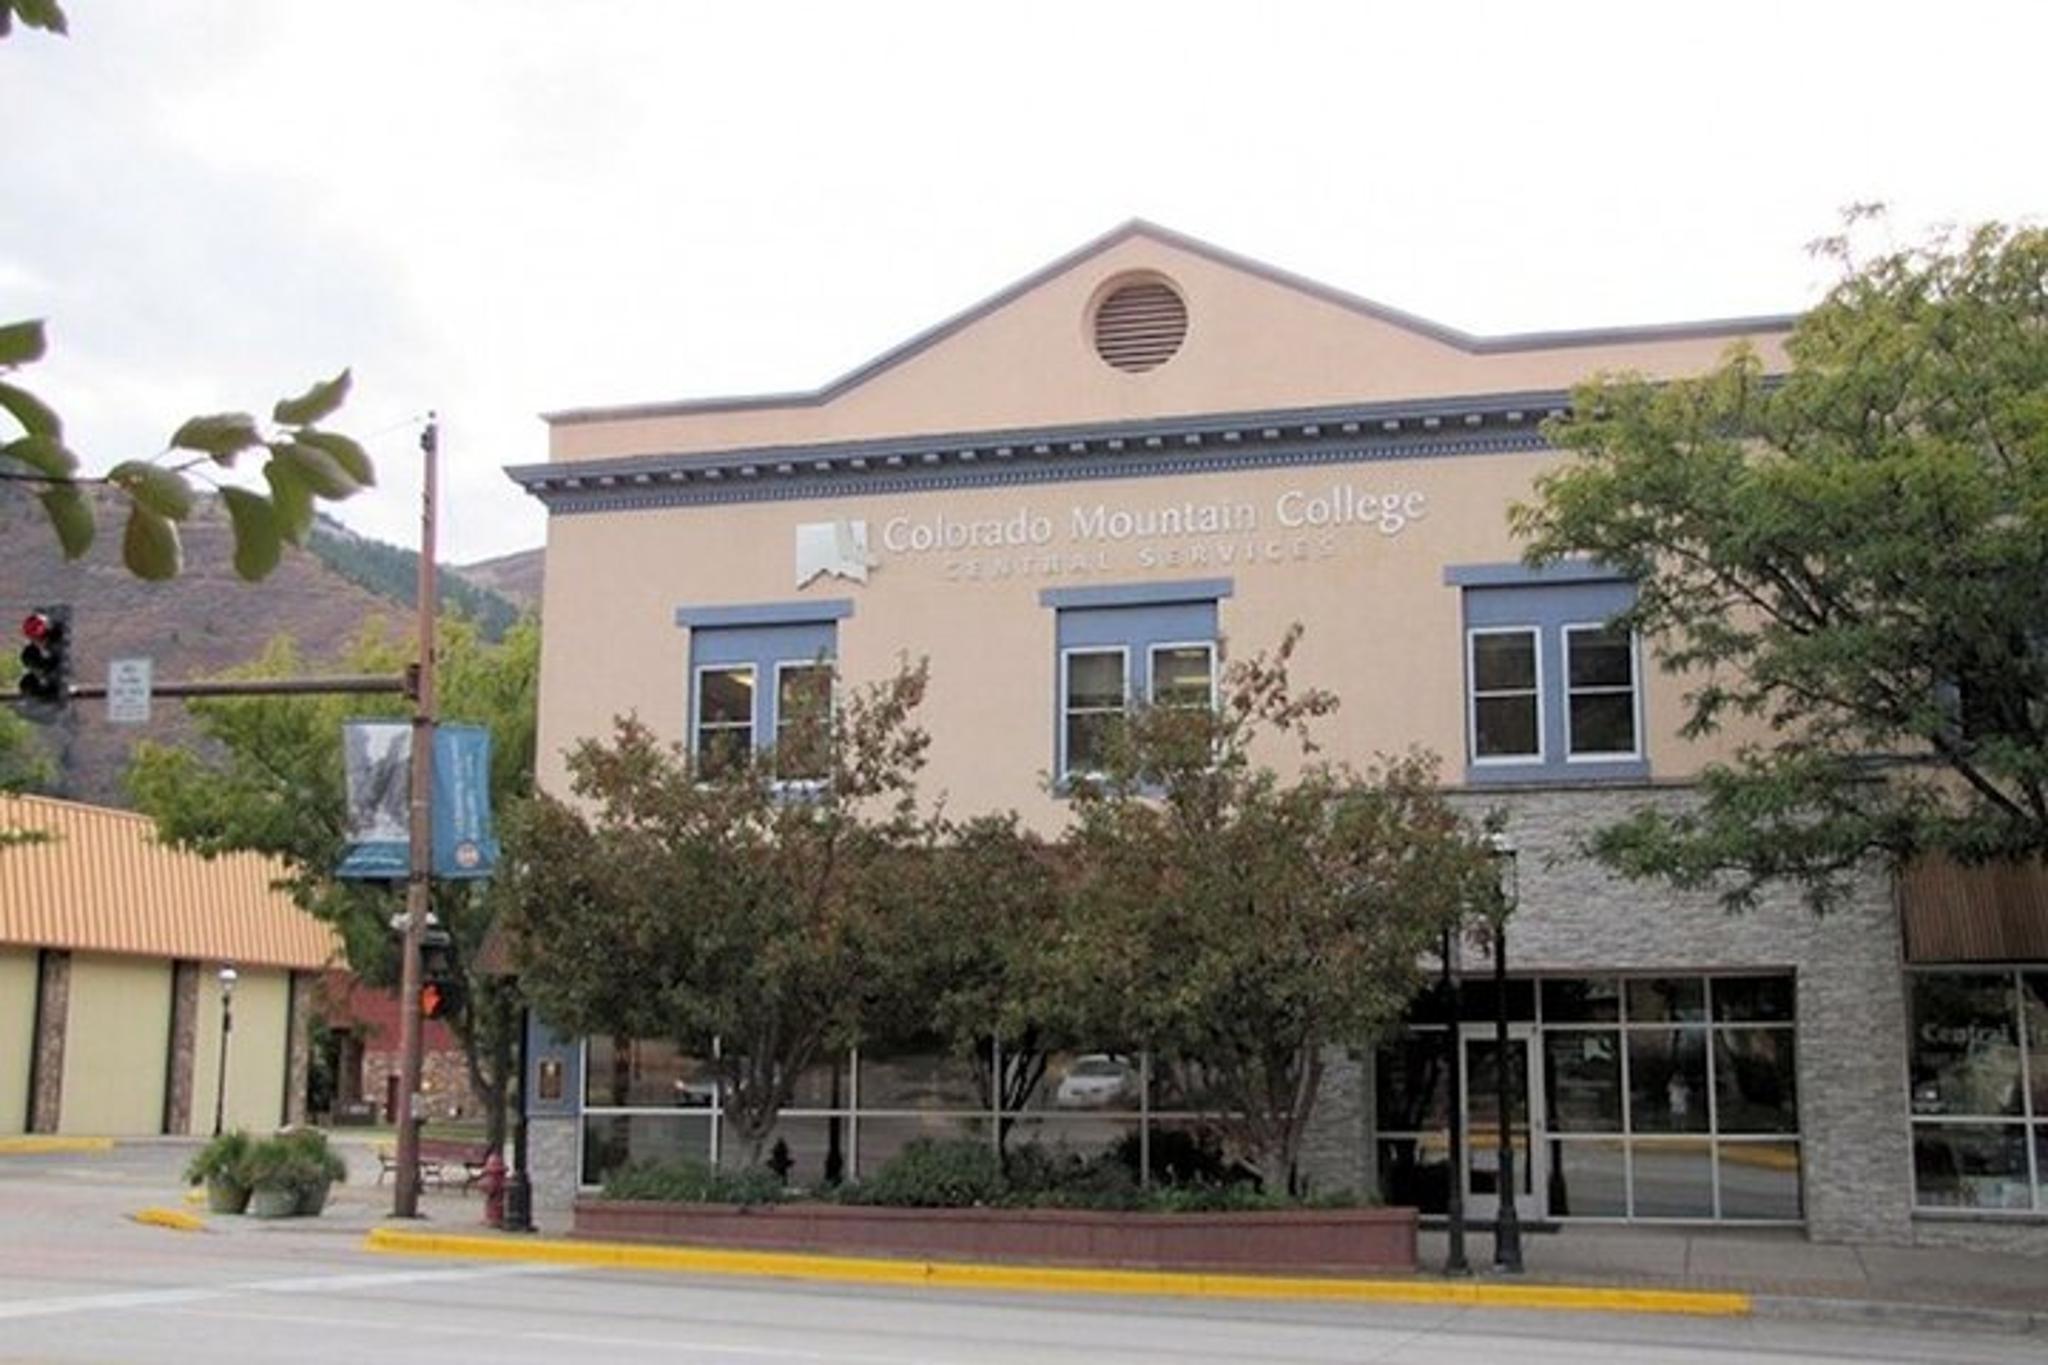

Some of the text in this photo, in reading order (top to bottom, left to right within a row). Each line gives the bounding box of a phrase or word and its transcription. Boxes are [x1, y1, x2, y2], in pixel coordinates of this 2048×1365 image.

[883, 485, 1425, 550] Colorado Mountain College
[948, 537, 1336, 580] CENTRAL SERVICES
